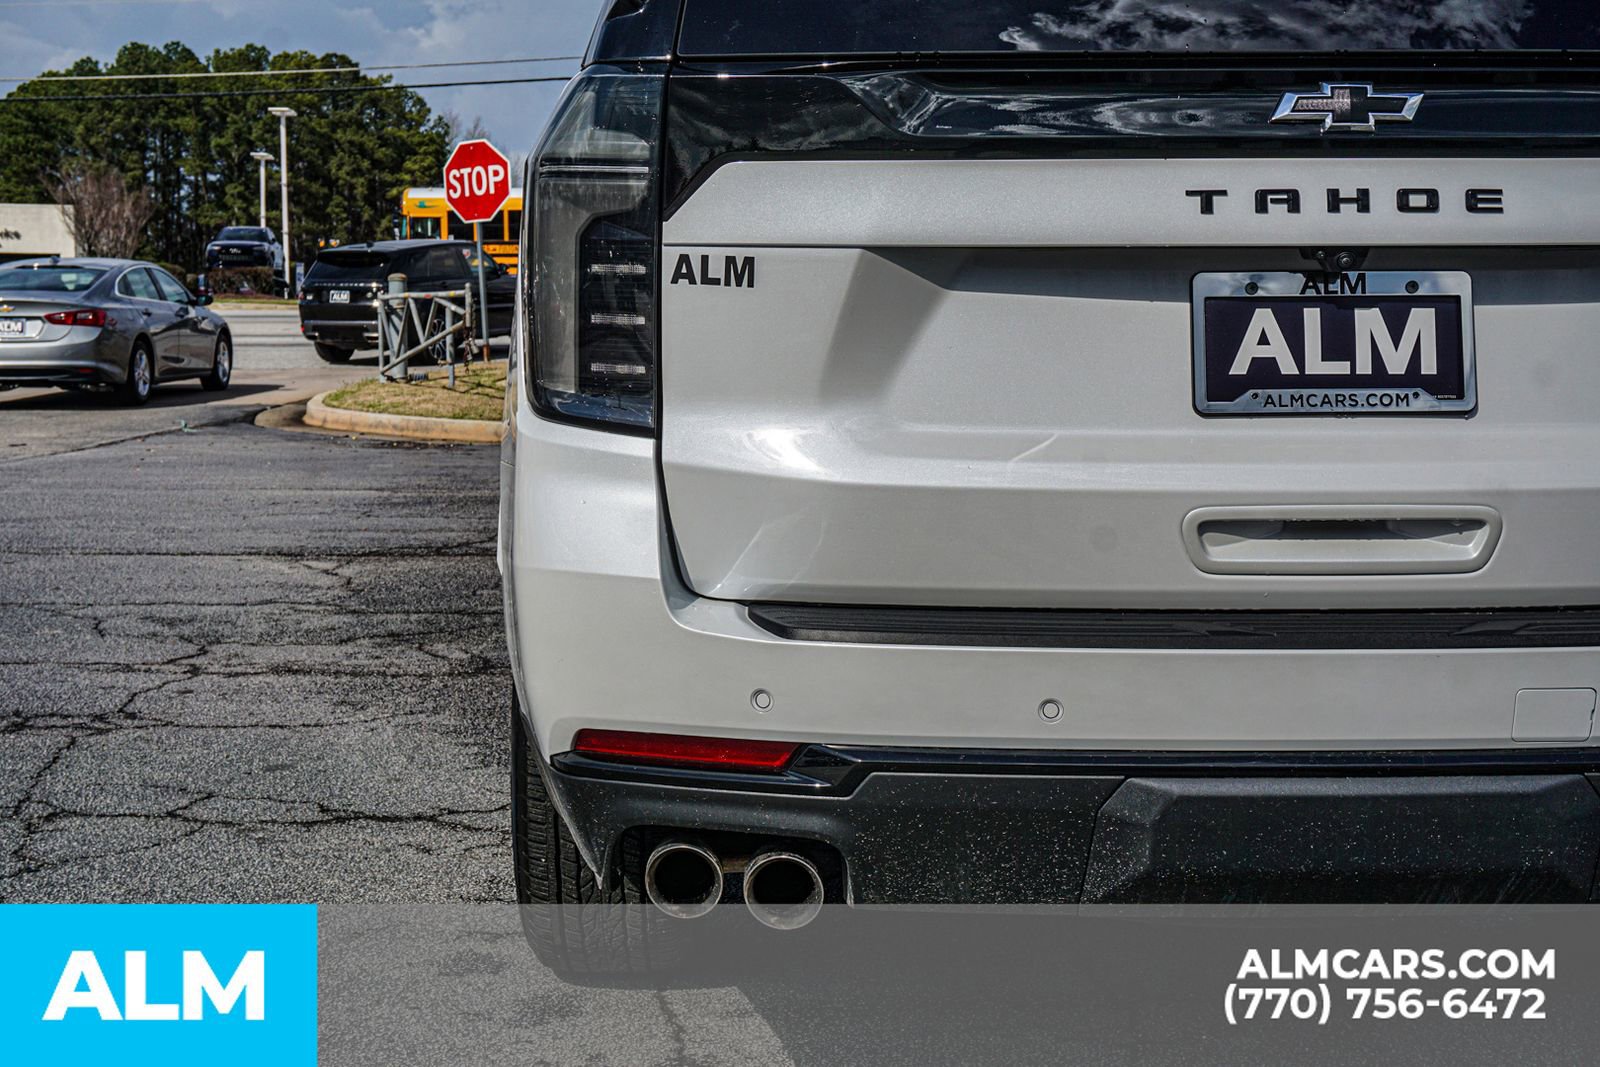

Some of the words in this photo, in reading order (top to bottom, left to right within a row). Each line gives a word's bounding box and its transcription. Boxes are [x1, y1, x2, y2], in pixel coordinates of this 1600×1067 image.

[448, 164, 505, 199] STOP
[1186, 188, 1504, 215] TAHOE
[670, 254, 756, 289] ALM
[1300, 272, 1366, 295] ALM
[1228, 307, 1438, 375] ALM
[1262, 393, 1410, 409] ALMCARS.COM
